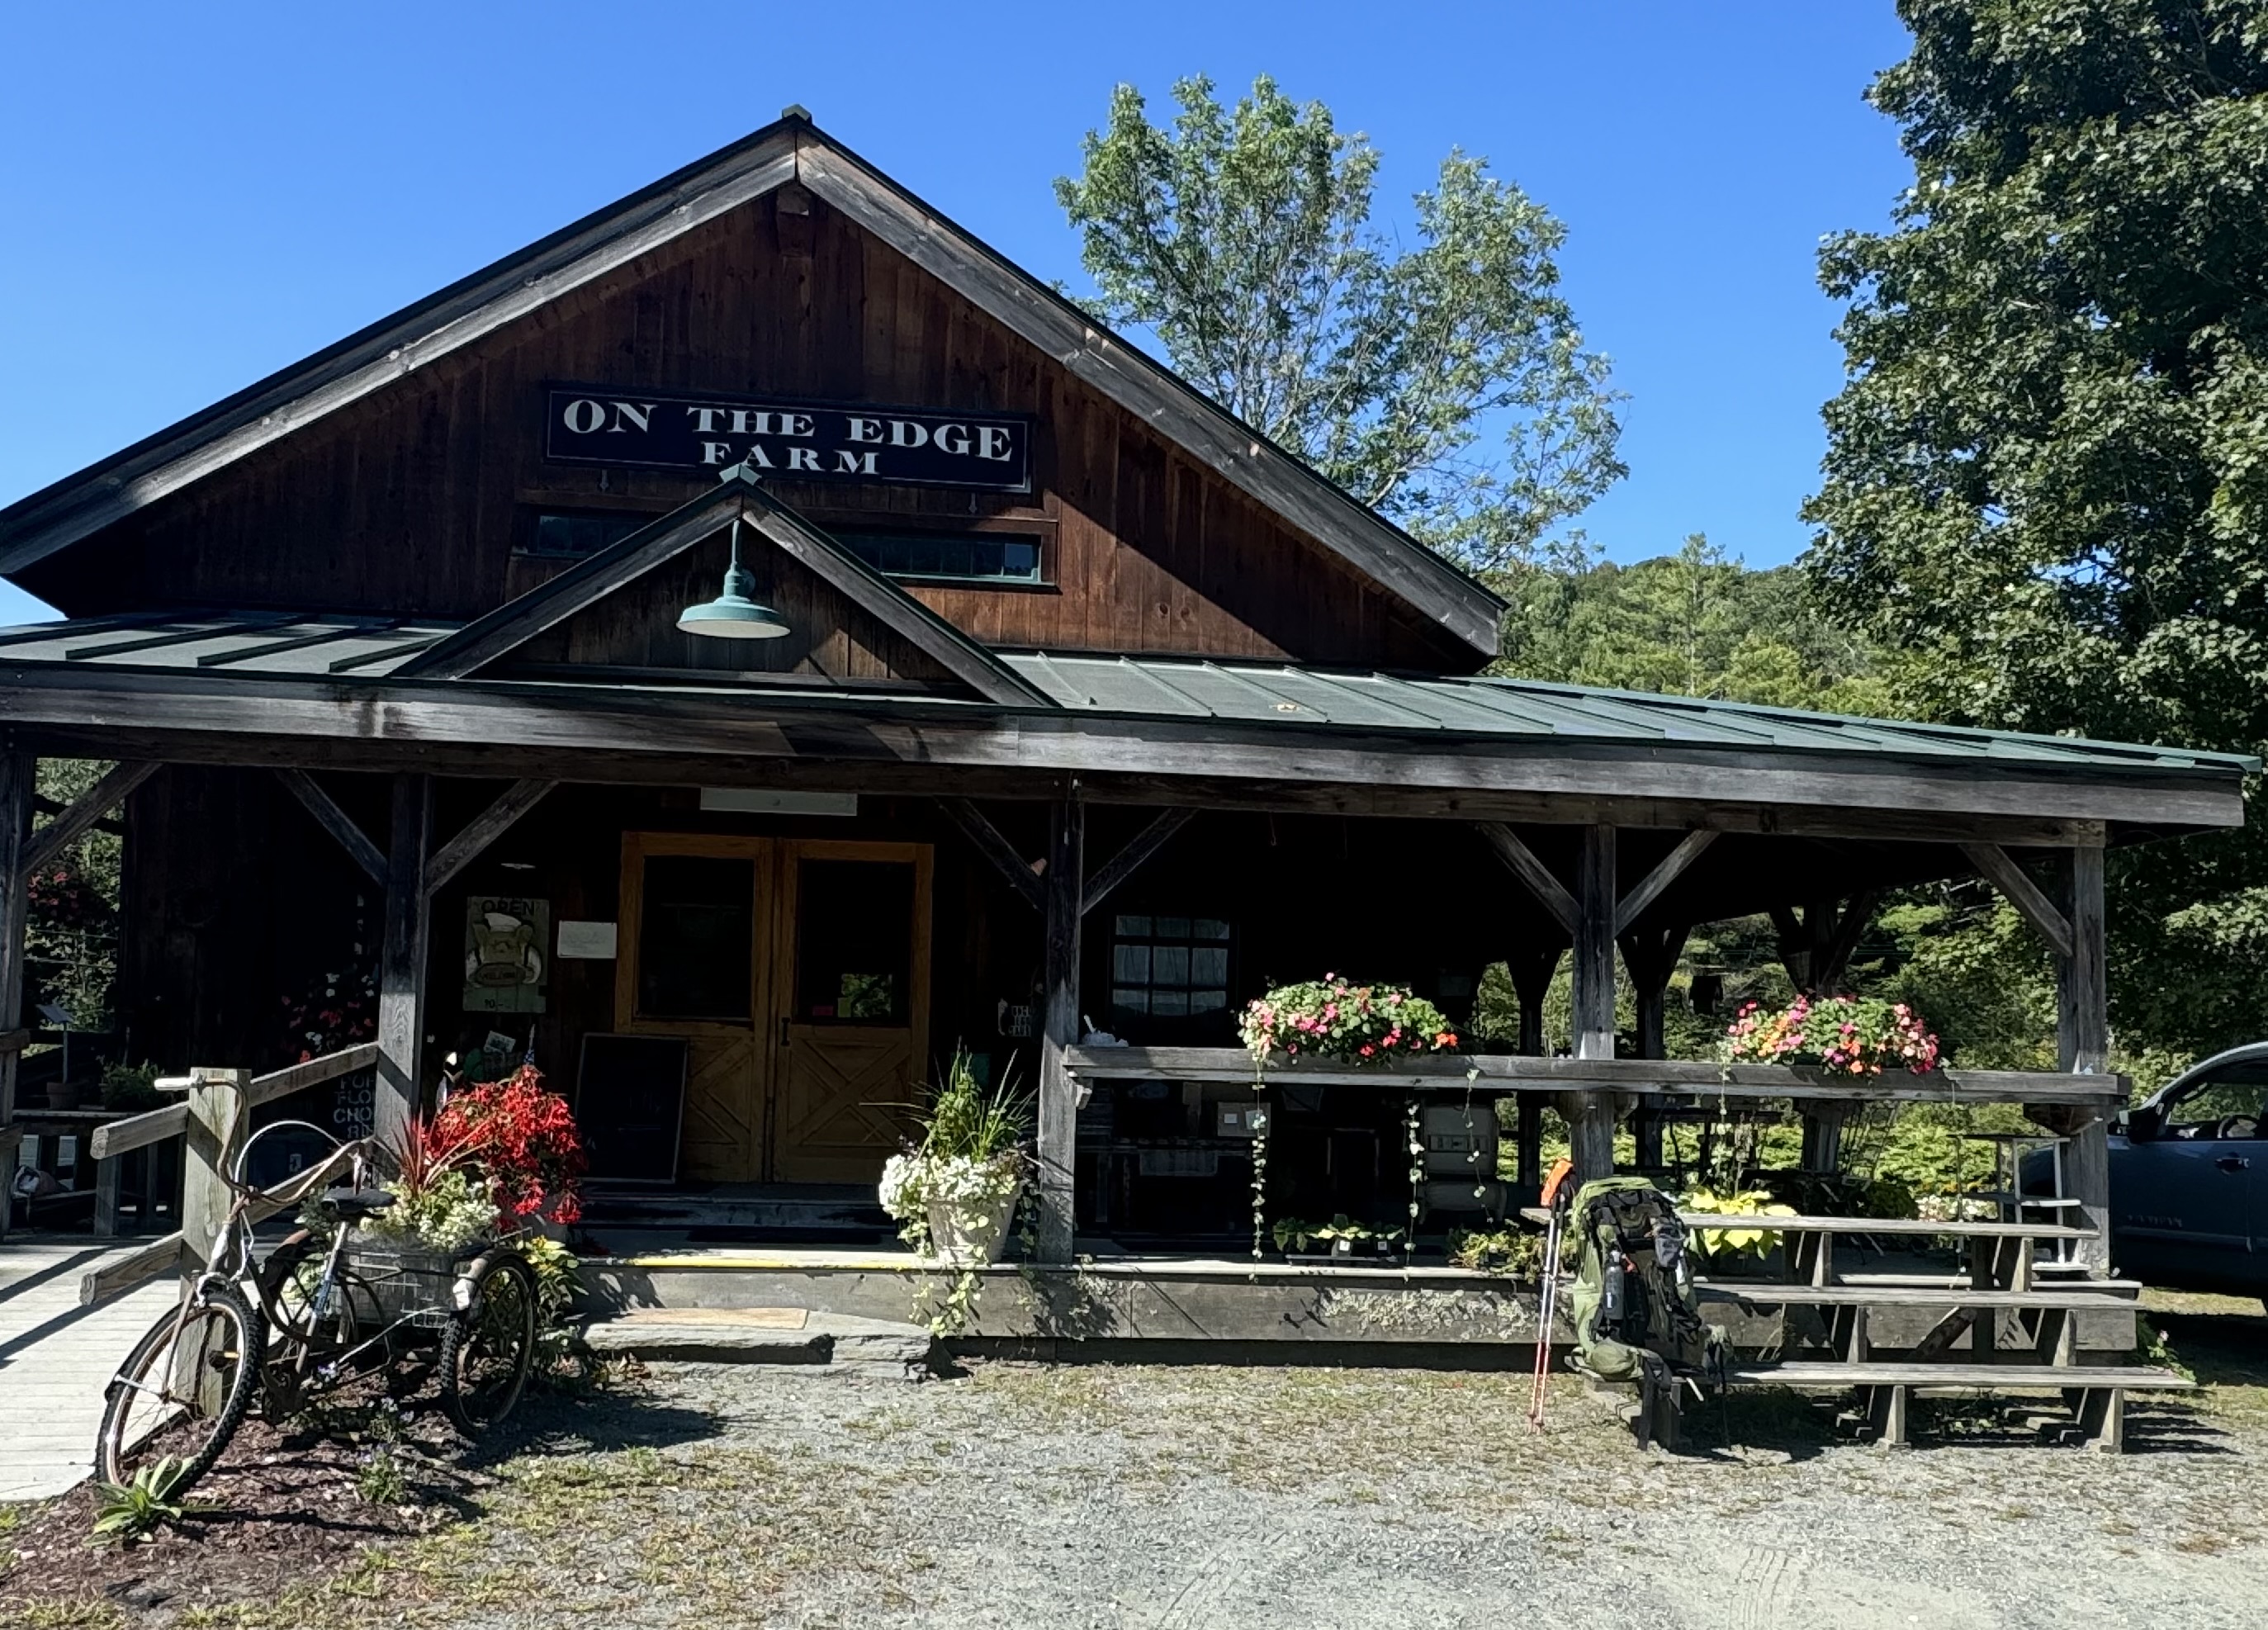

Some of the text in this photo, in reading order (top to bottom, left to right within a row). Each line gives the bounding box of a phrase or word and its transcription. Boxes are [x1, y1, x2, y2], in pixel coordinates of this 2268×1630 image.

[563, 399, 1013, 462] ON THE EDGE
[698, 442, 881, 476] FARM
[481, 899, 535, 917] OPEN
